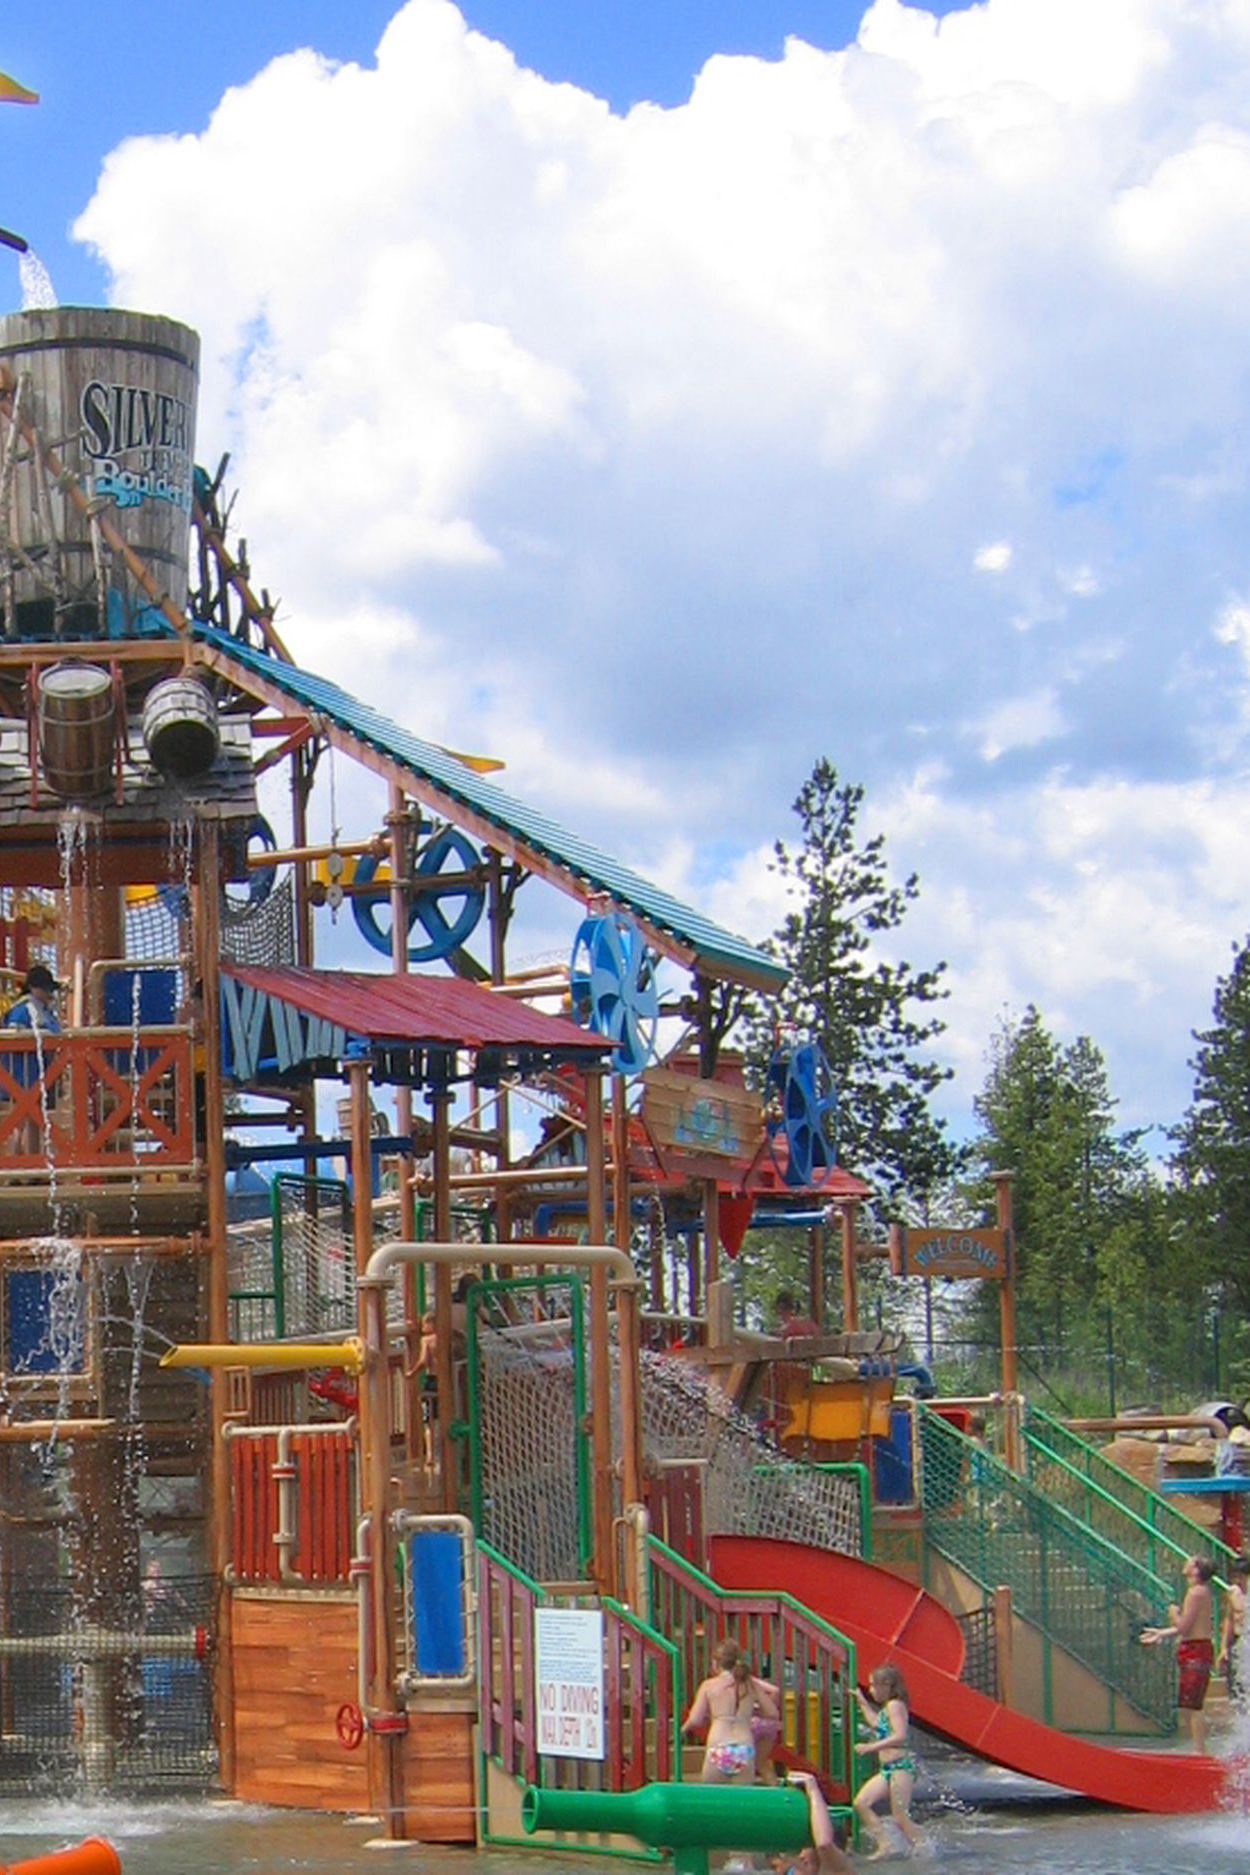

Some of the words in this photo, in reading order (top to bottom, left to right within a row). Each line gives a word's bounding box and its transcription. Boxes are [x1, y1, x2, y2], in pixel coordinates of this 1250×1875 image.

[913, 1233, 999, 1271] WELCOME
[539, 1682, 556, 1712] NO
[560, 1684, 599, 1715] DIVING
